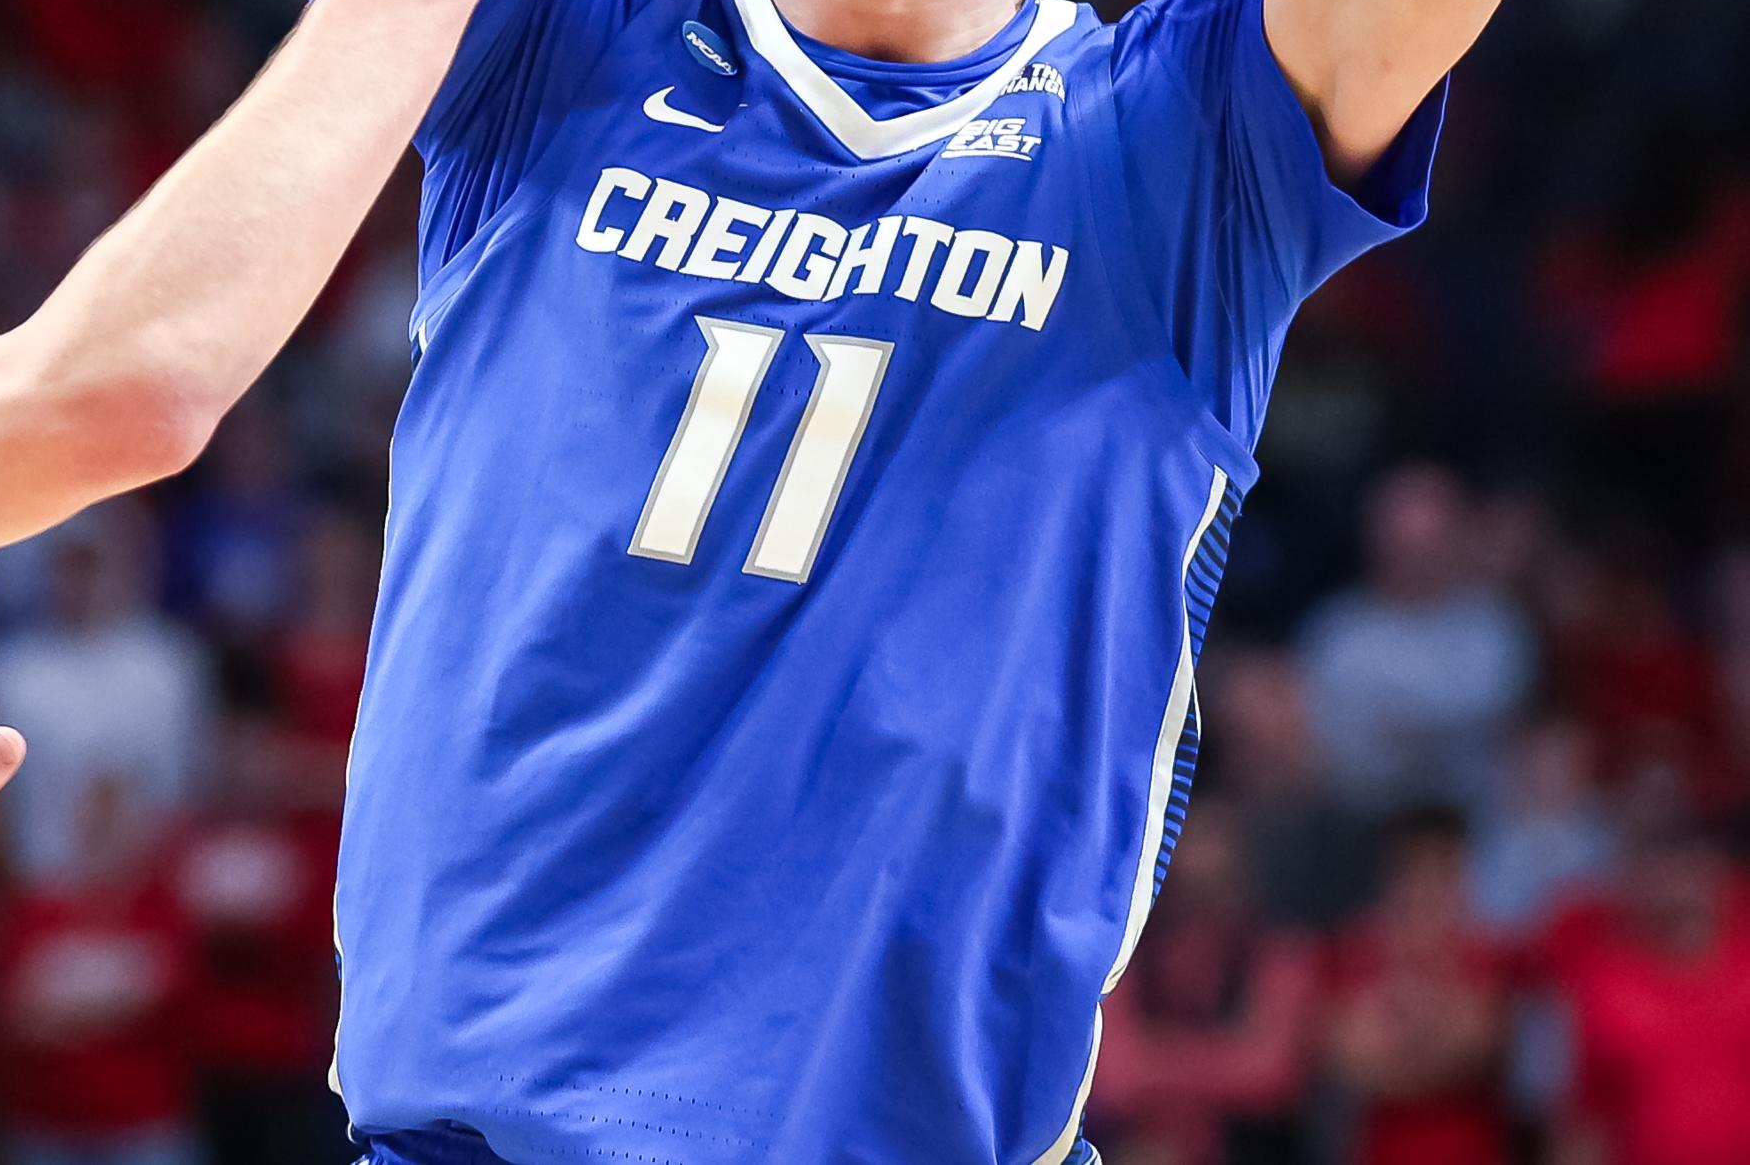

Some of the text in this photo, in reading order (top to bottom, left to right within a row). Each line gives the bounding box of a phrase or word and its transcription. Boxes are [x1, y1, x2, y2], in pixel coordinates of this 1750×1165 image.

[685, 31, 733, 74] NCAA
[999, 75, 1066, 105] HANG
[945, 134, 1043, 155] EAST
[958, 117, 1027, 136] BIG
[575, 166, 1070, 332] CREIGHTON
[626, 315, 895, 584] 11
